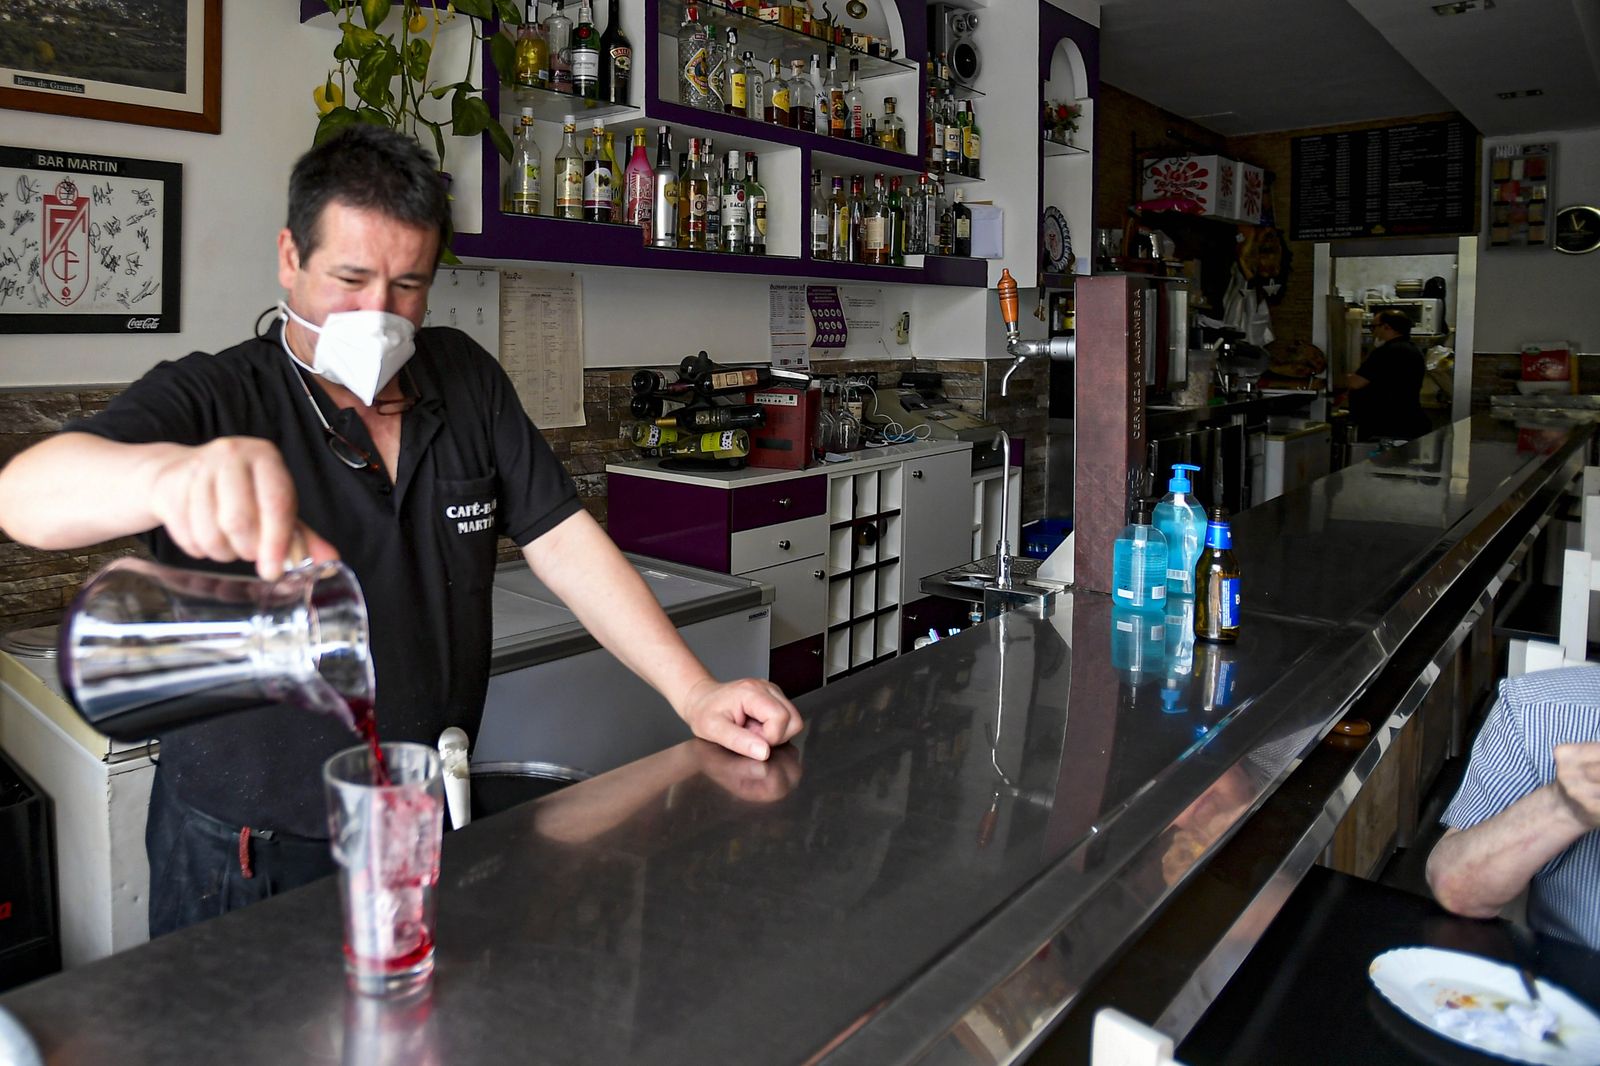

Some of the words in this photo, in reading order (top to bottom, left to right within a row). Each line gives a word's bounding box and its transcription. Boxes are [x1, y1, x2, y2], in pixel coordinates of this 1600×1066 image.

[17, 77, 36, 86] Beas
[38, 79, 48, 87] de
[50, 81, 84, 93] Granada
[38, 154, 64, 167] BAR
[67, 157, 118, 173] MARTIN
[1133, 288, 1141, 364] ALHAMBRA
[1133, 371, 1141, 440] CERVEZAS
